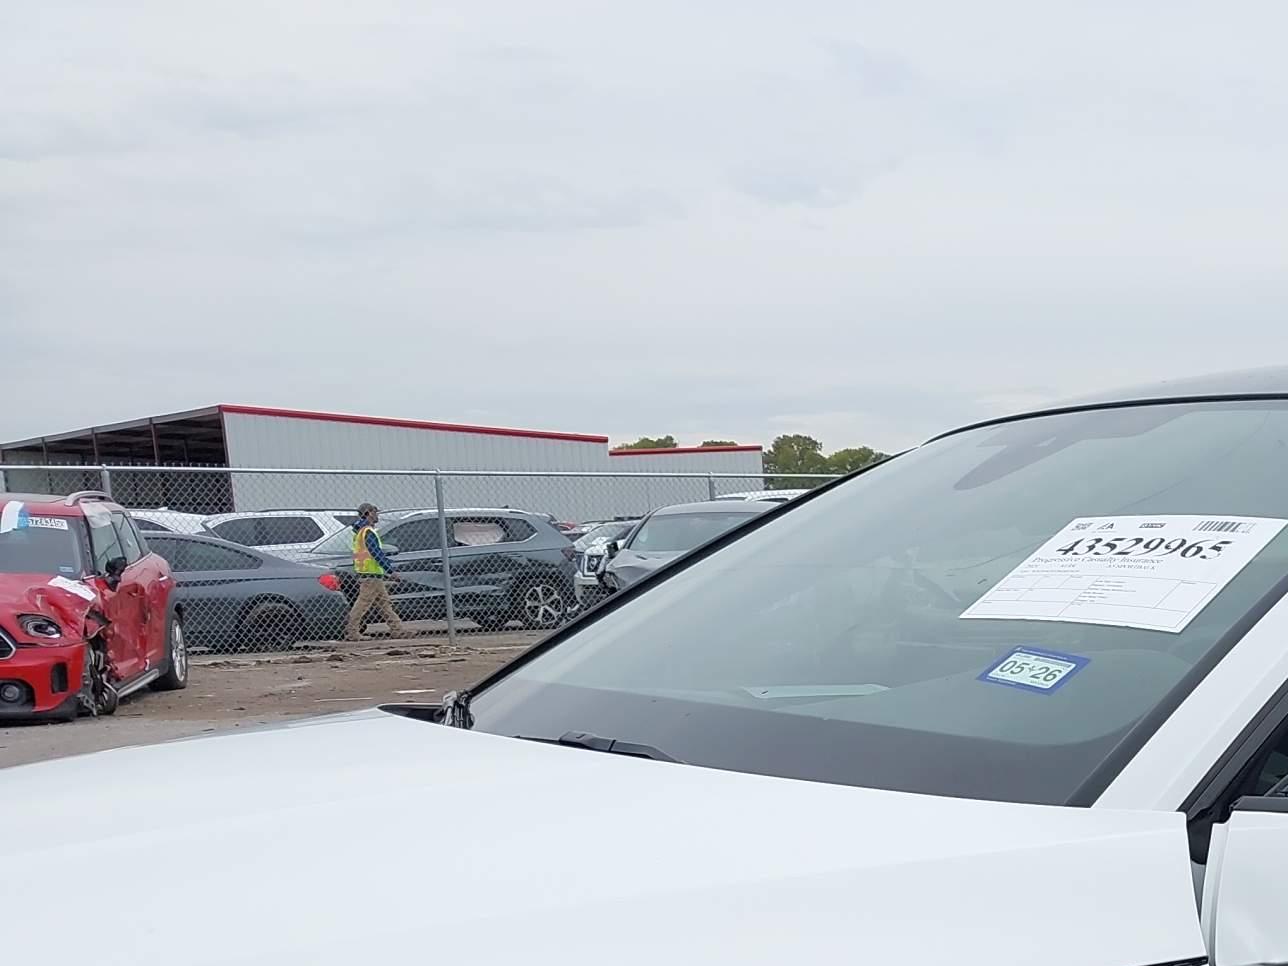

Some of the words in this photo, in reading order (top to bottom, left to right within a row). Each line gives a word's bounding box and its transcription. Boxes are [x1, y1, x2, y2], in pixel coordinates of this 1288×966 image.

[1056, 537, 1232, 560] 43529965
[999, 660, 1030, 675] 05
[1029, 666, 1062, 682] 26
